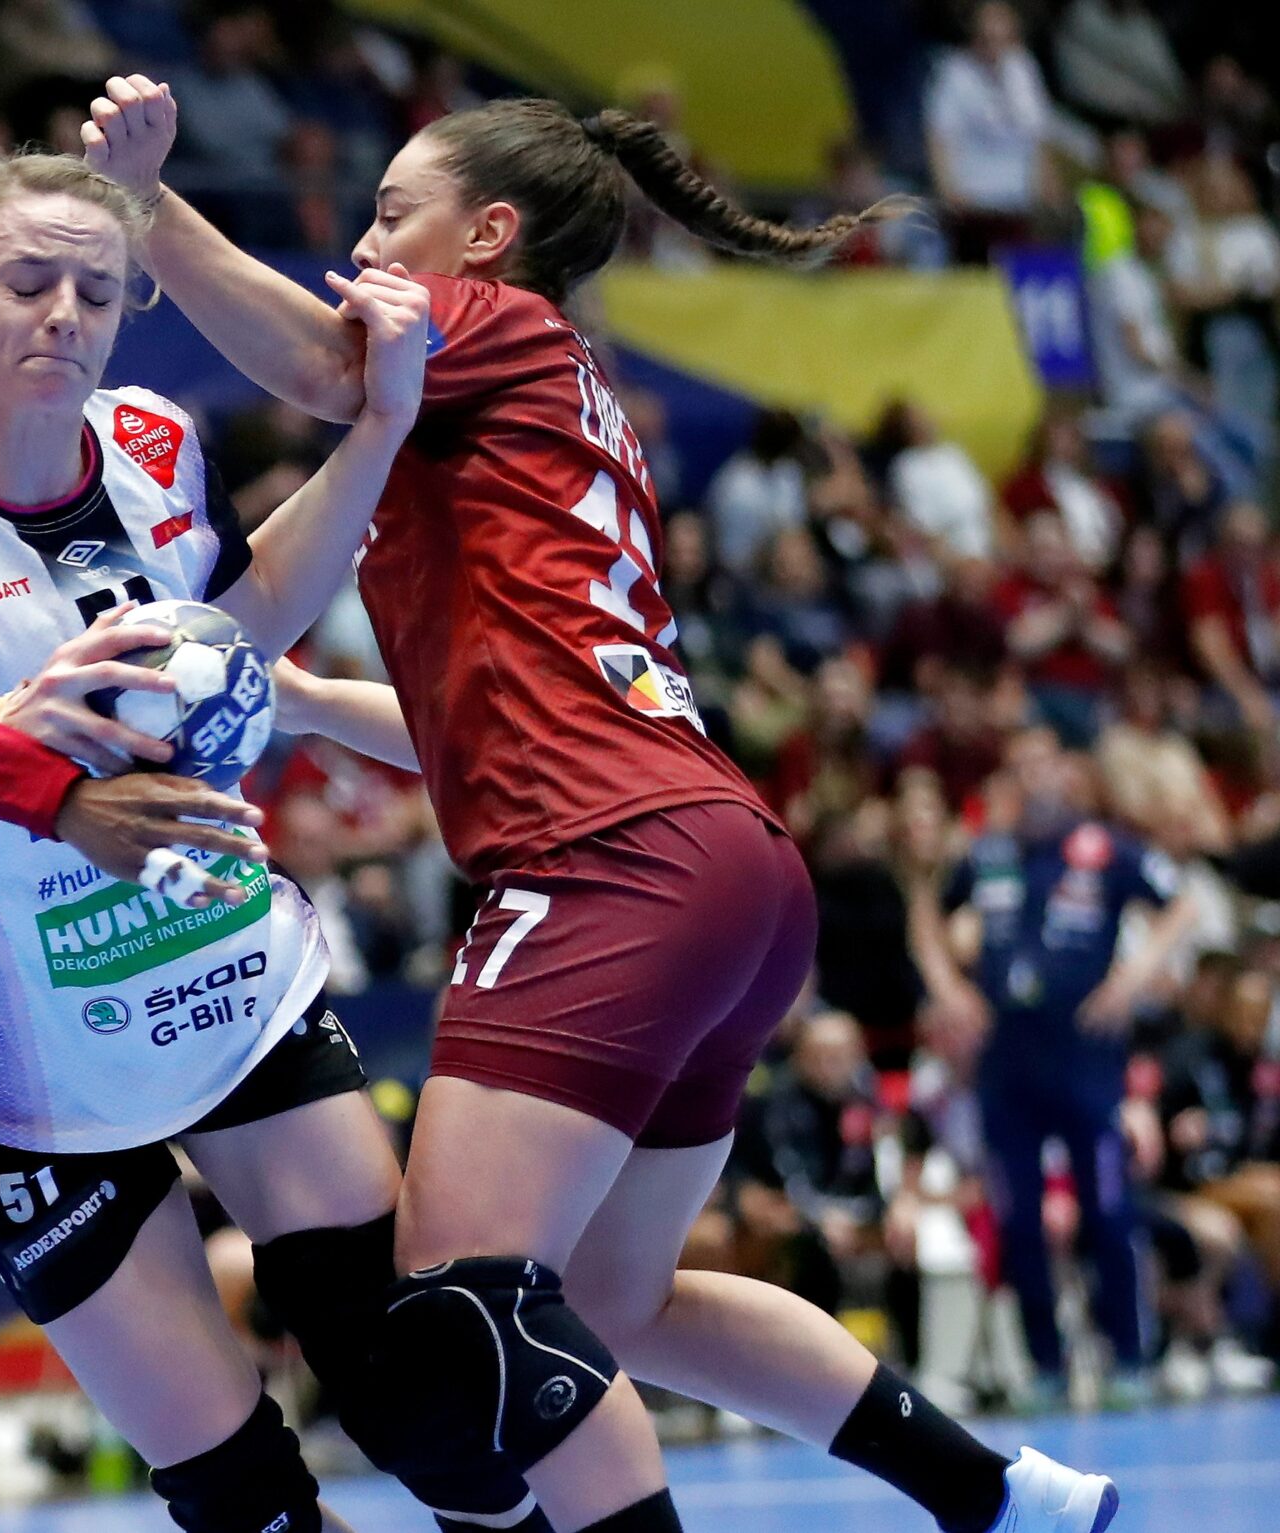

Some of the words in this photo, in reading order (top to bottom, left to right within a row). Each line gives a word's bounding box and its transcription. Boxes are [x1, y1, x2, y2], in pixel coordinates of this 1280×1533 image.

[123, 425, 171, 454] HENNIG
[132, 439, 174, 466] OLSEN
[191, 652, 268, 758] SELECT
[52, 934, 156, 971] DEKORATIVE
[144, 950, 268, 1018] ŠKOD
[150, 996, 234, 1047] G-Bil
[12, 1191, 103, 1271] AGDERPORT
